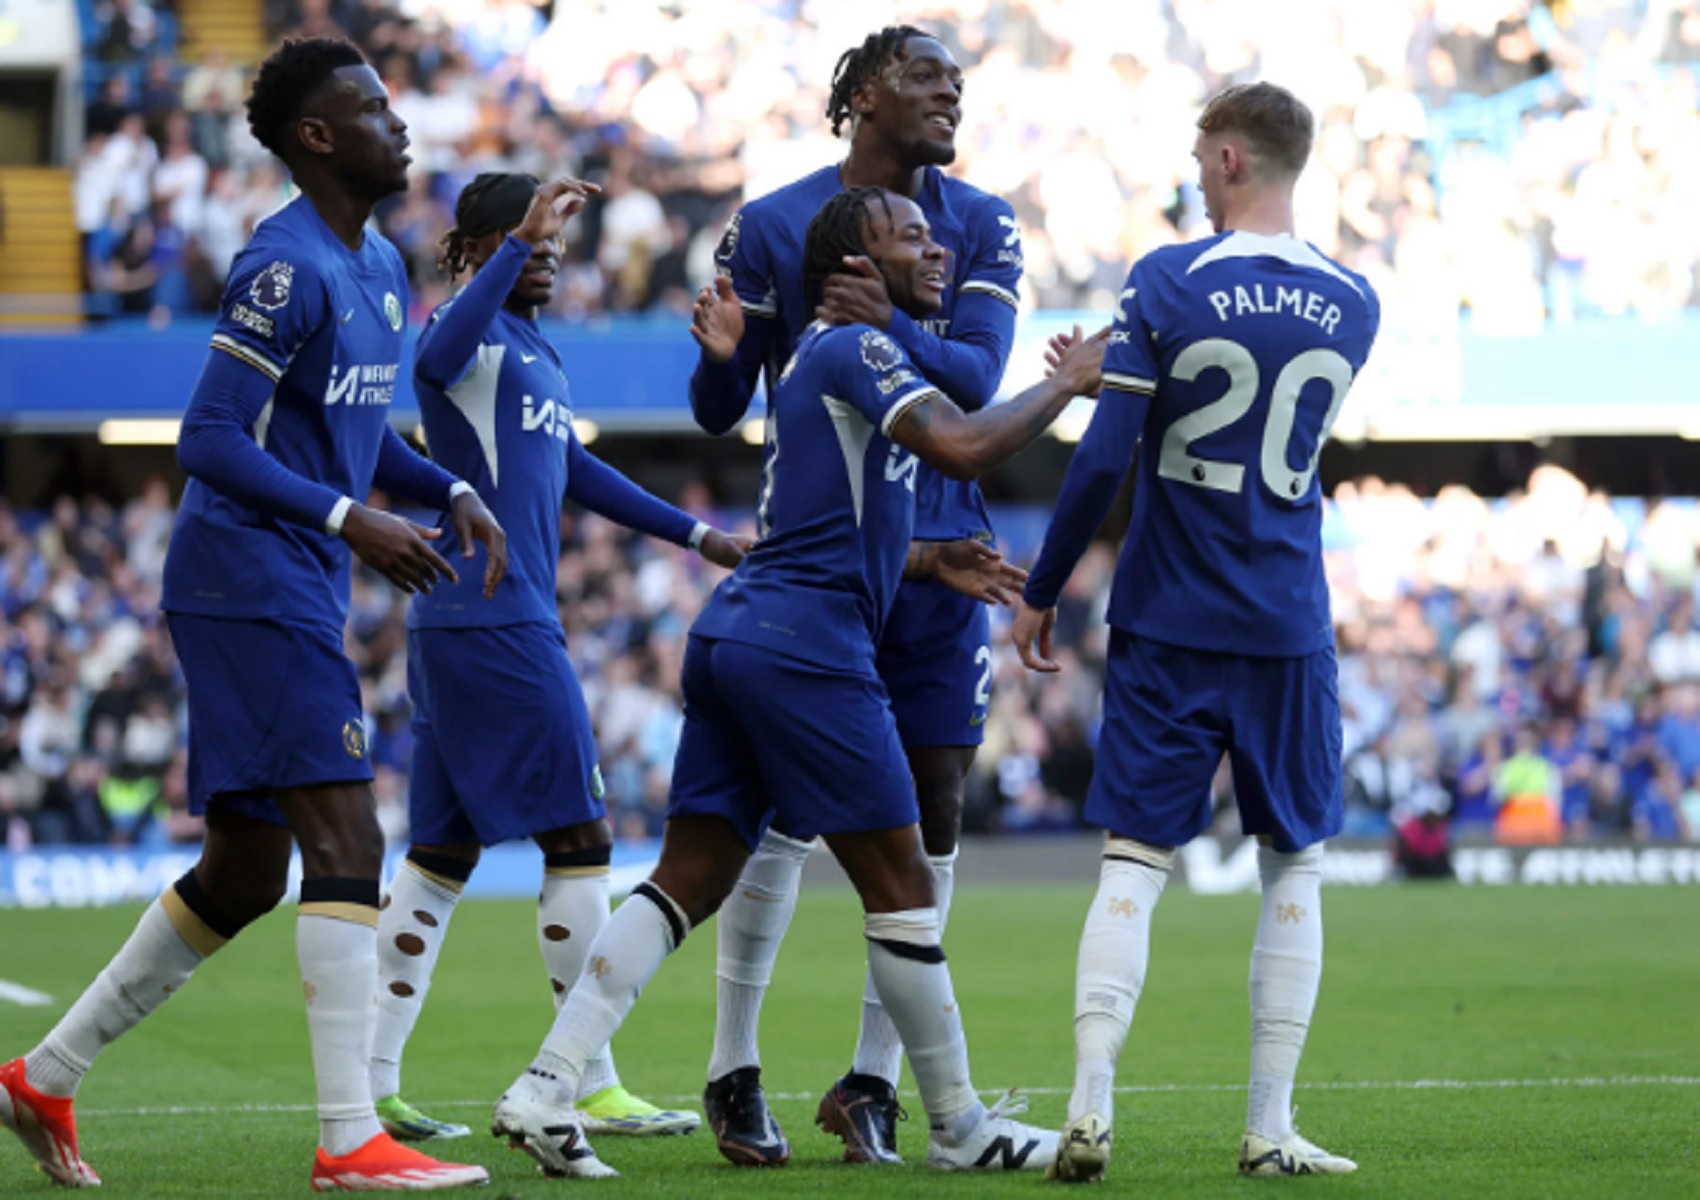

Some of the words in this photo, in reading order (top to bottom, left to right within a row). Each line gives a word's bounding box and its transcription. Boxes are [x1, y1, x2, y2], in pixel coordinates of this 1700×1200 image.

[1208, 284, 1341, 335] PALMER
[1158, 337, 1353, 500] 20
[974, 645, 990, 705] 2
